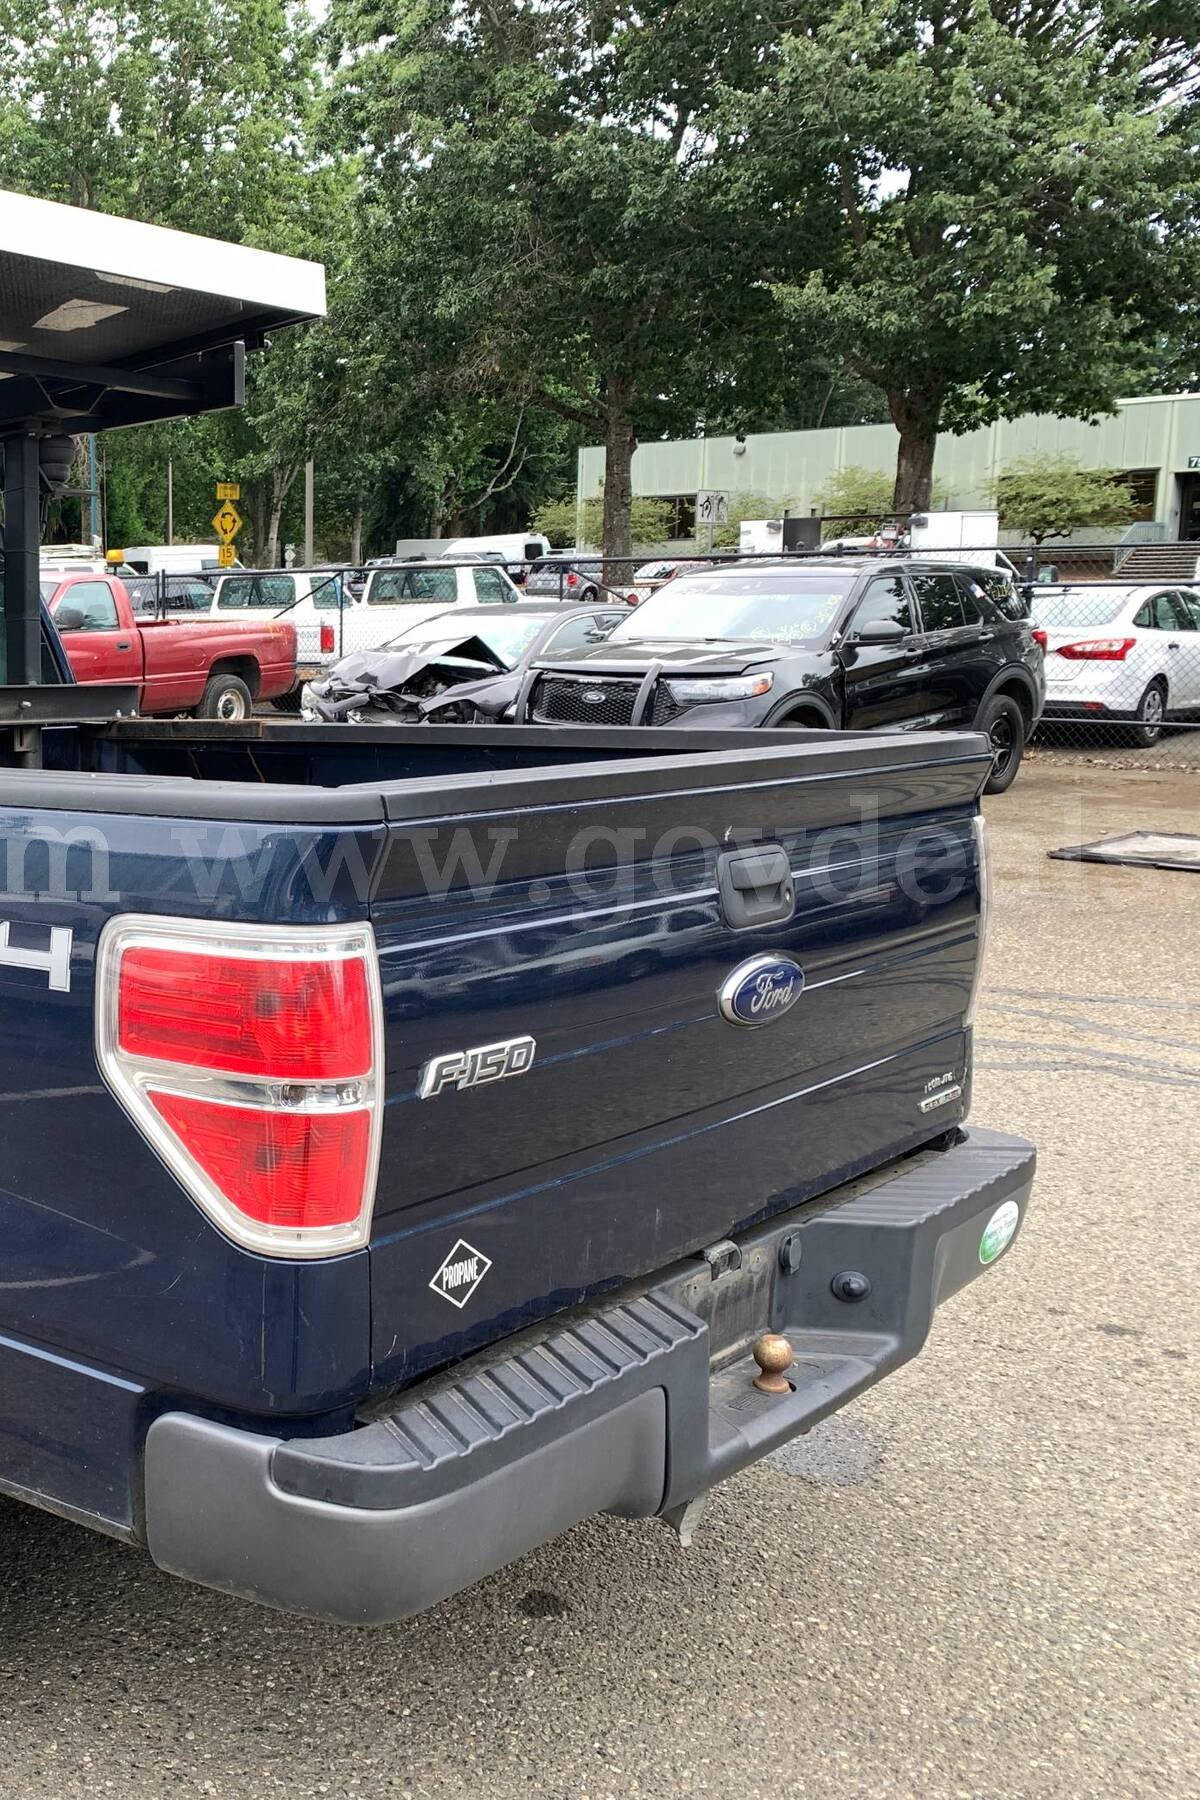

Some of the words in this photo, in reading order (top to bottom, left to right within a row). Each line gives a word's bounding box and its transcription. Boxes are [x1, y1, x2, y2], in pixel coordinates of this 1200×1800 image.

[1191, 457, 1200, 468] 7
[221, 547, 233, 560] 15
[751, 970, 795, 1014] Ford
[419, 1035, 536, 1100] F-150
[442, 1256, 479, 1291] PROPANE
